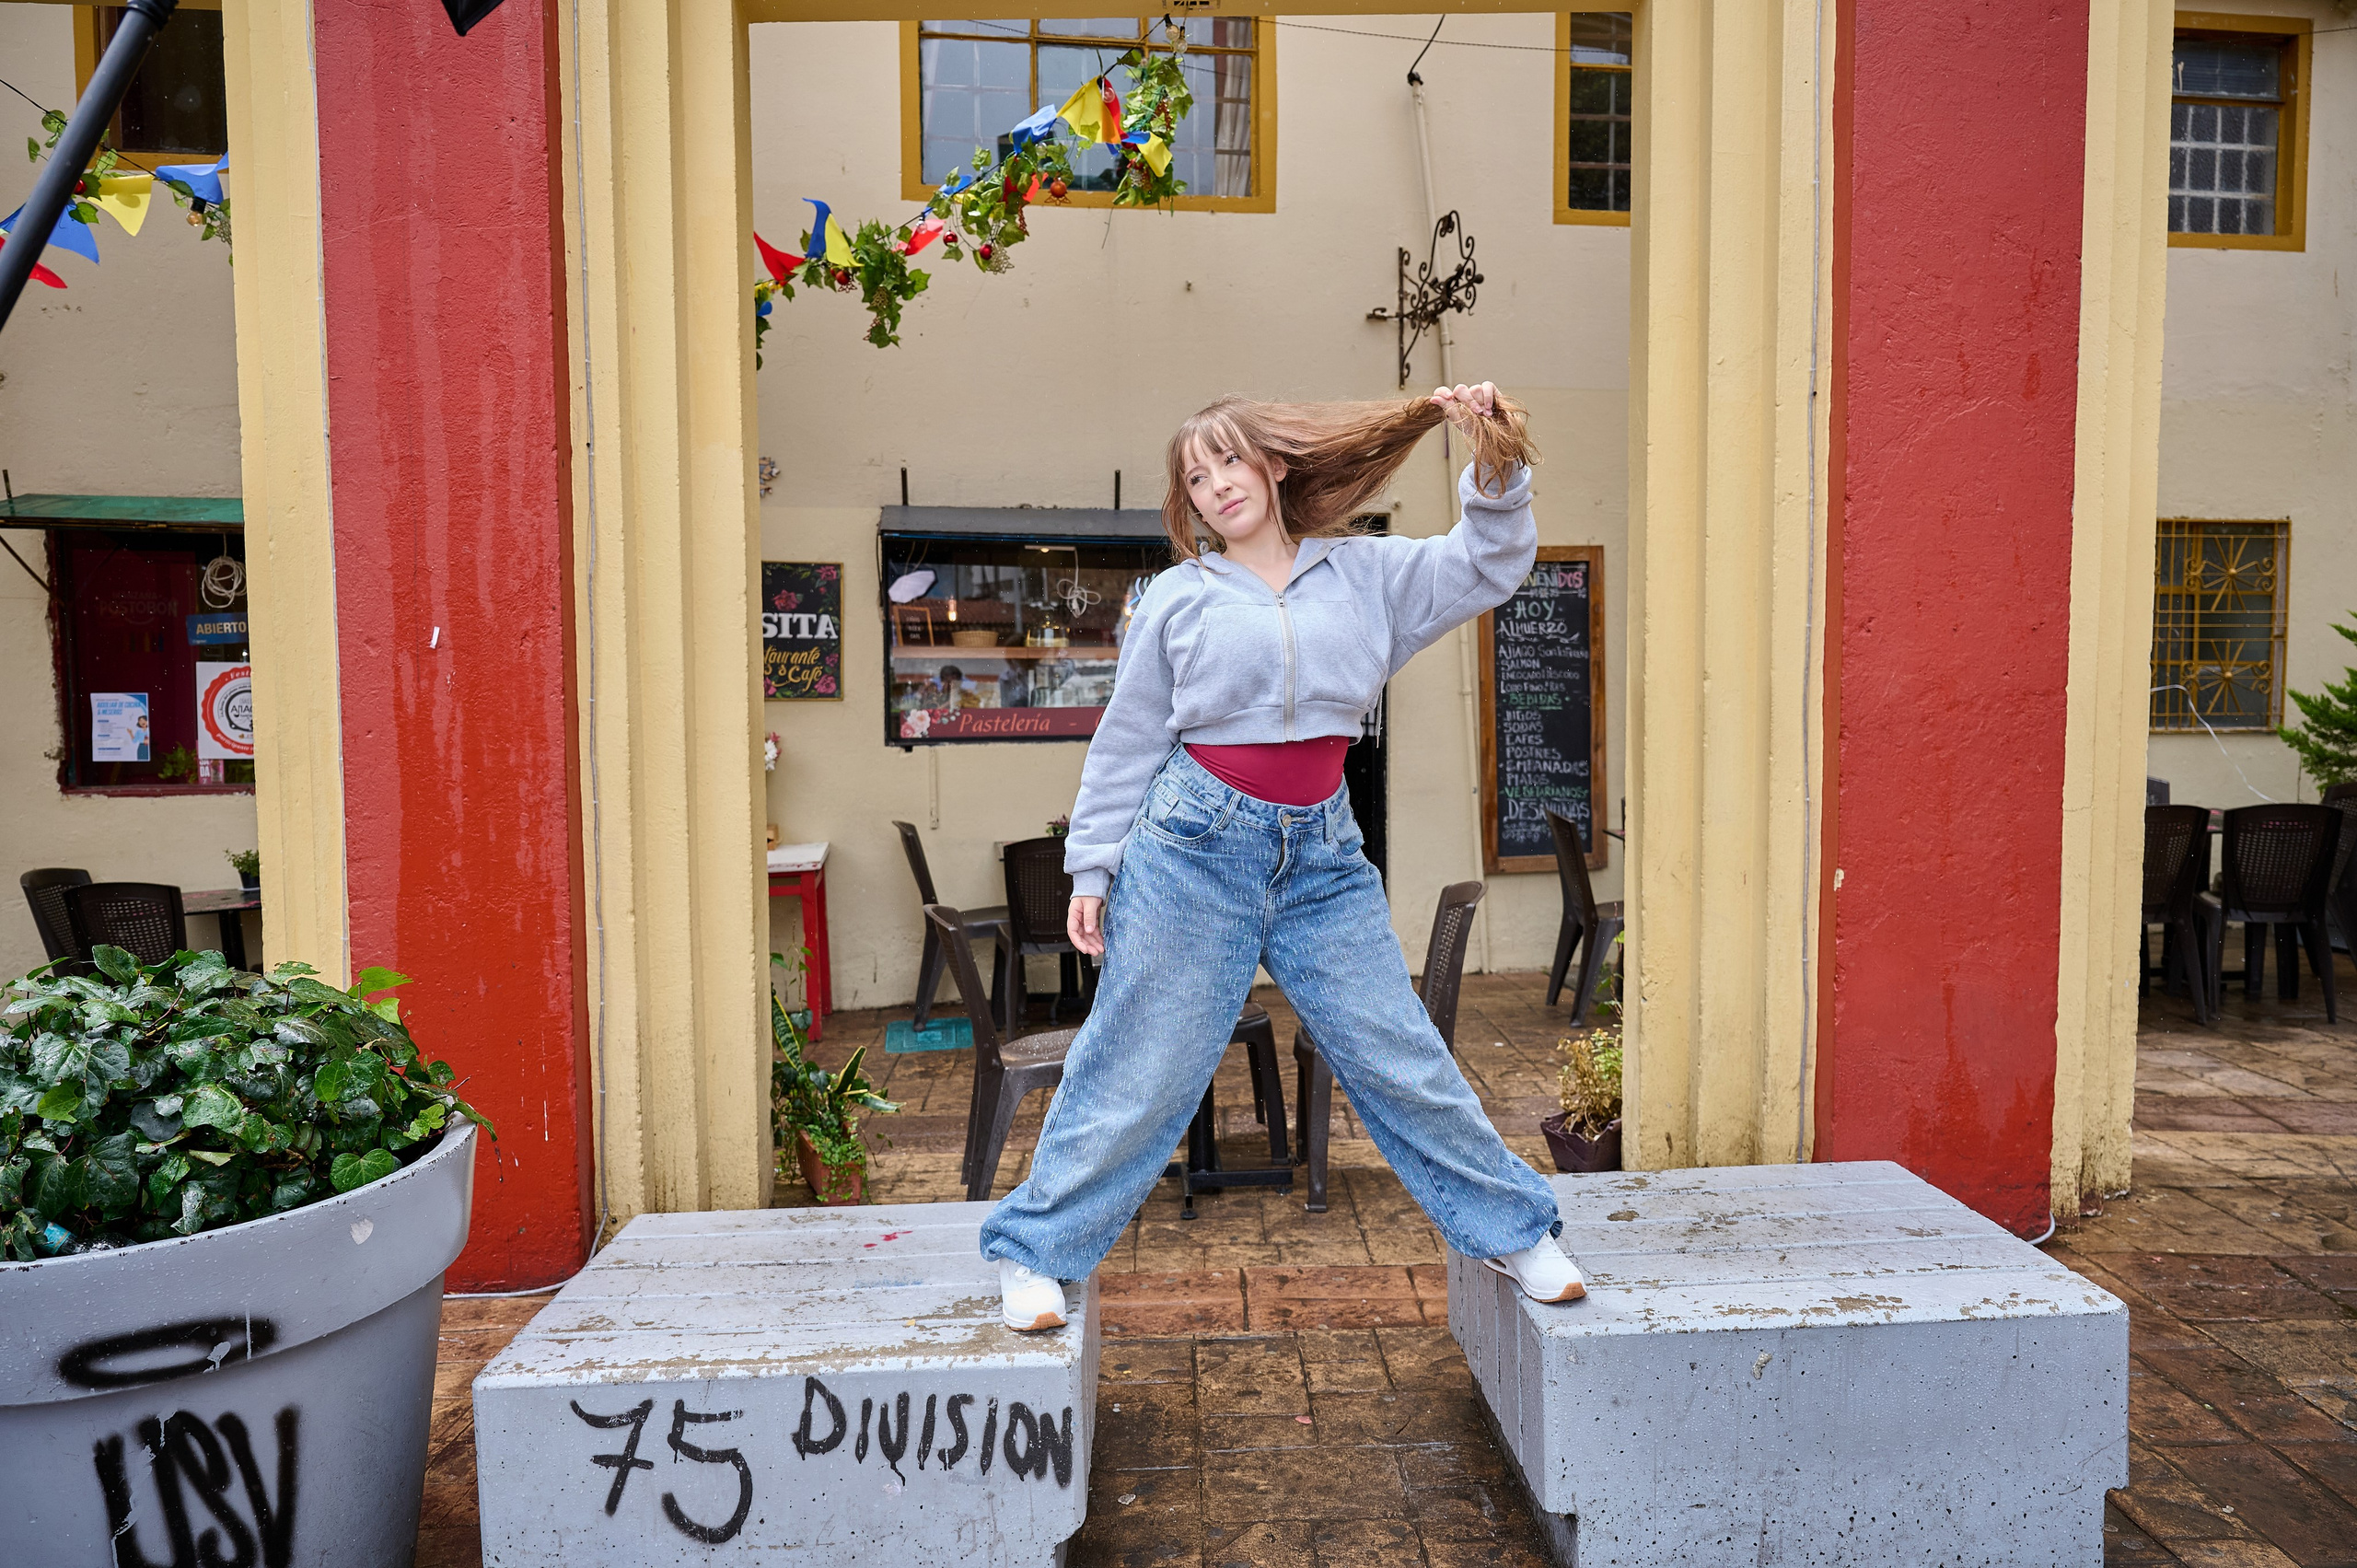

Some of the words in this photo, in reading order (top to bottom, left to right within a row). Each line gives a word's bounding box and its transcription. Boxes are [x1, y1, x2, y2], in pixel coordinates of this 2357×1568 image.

[1515, 600, 1554, 621] HOY
[196, 621, 247, 635] ABIERTO
[762, 612, 839, 640] SITA
[1510, 693, 1562, 706] BEBIDAS
[1504, 722, 1543, 734] SODAS
[1506, 747, 1561, 760] POSTRES
[570, 1399, 753, 1544] 75
[791, 1376, 1074, 1488] DIVISION
